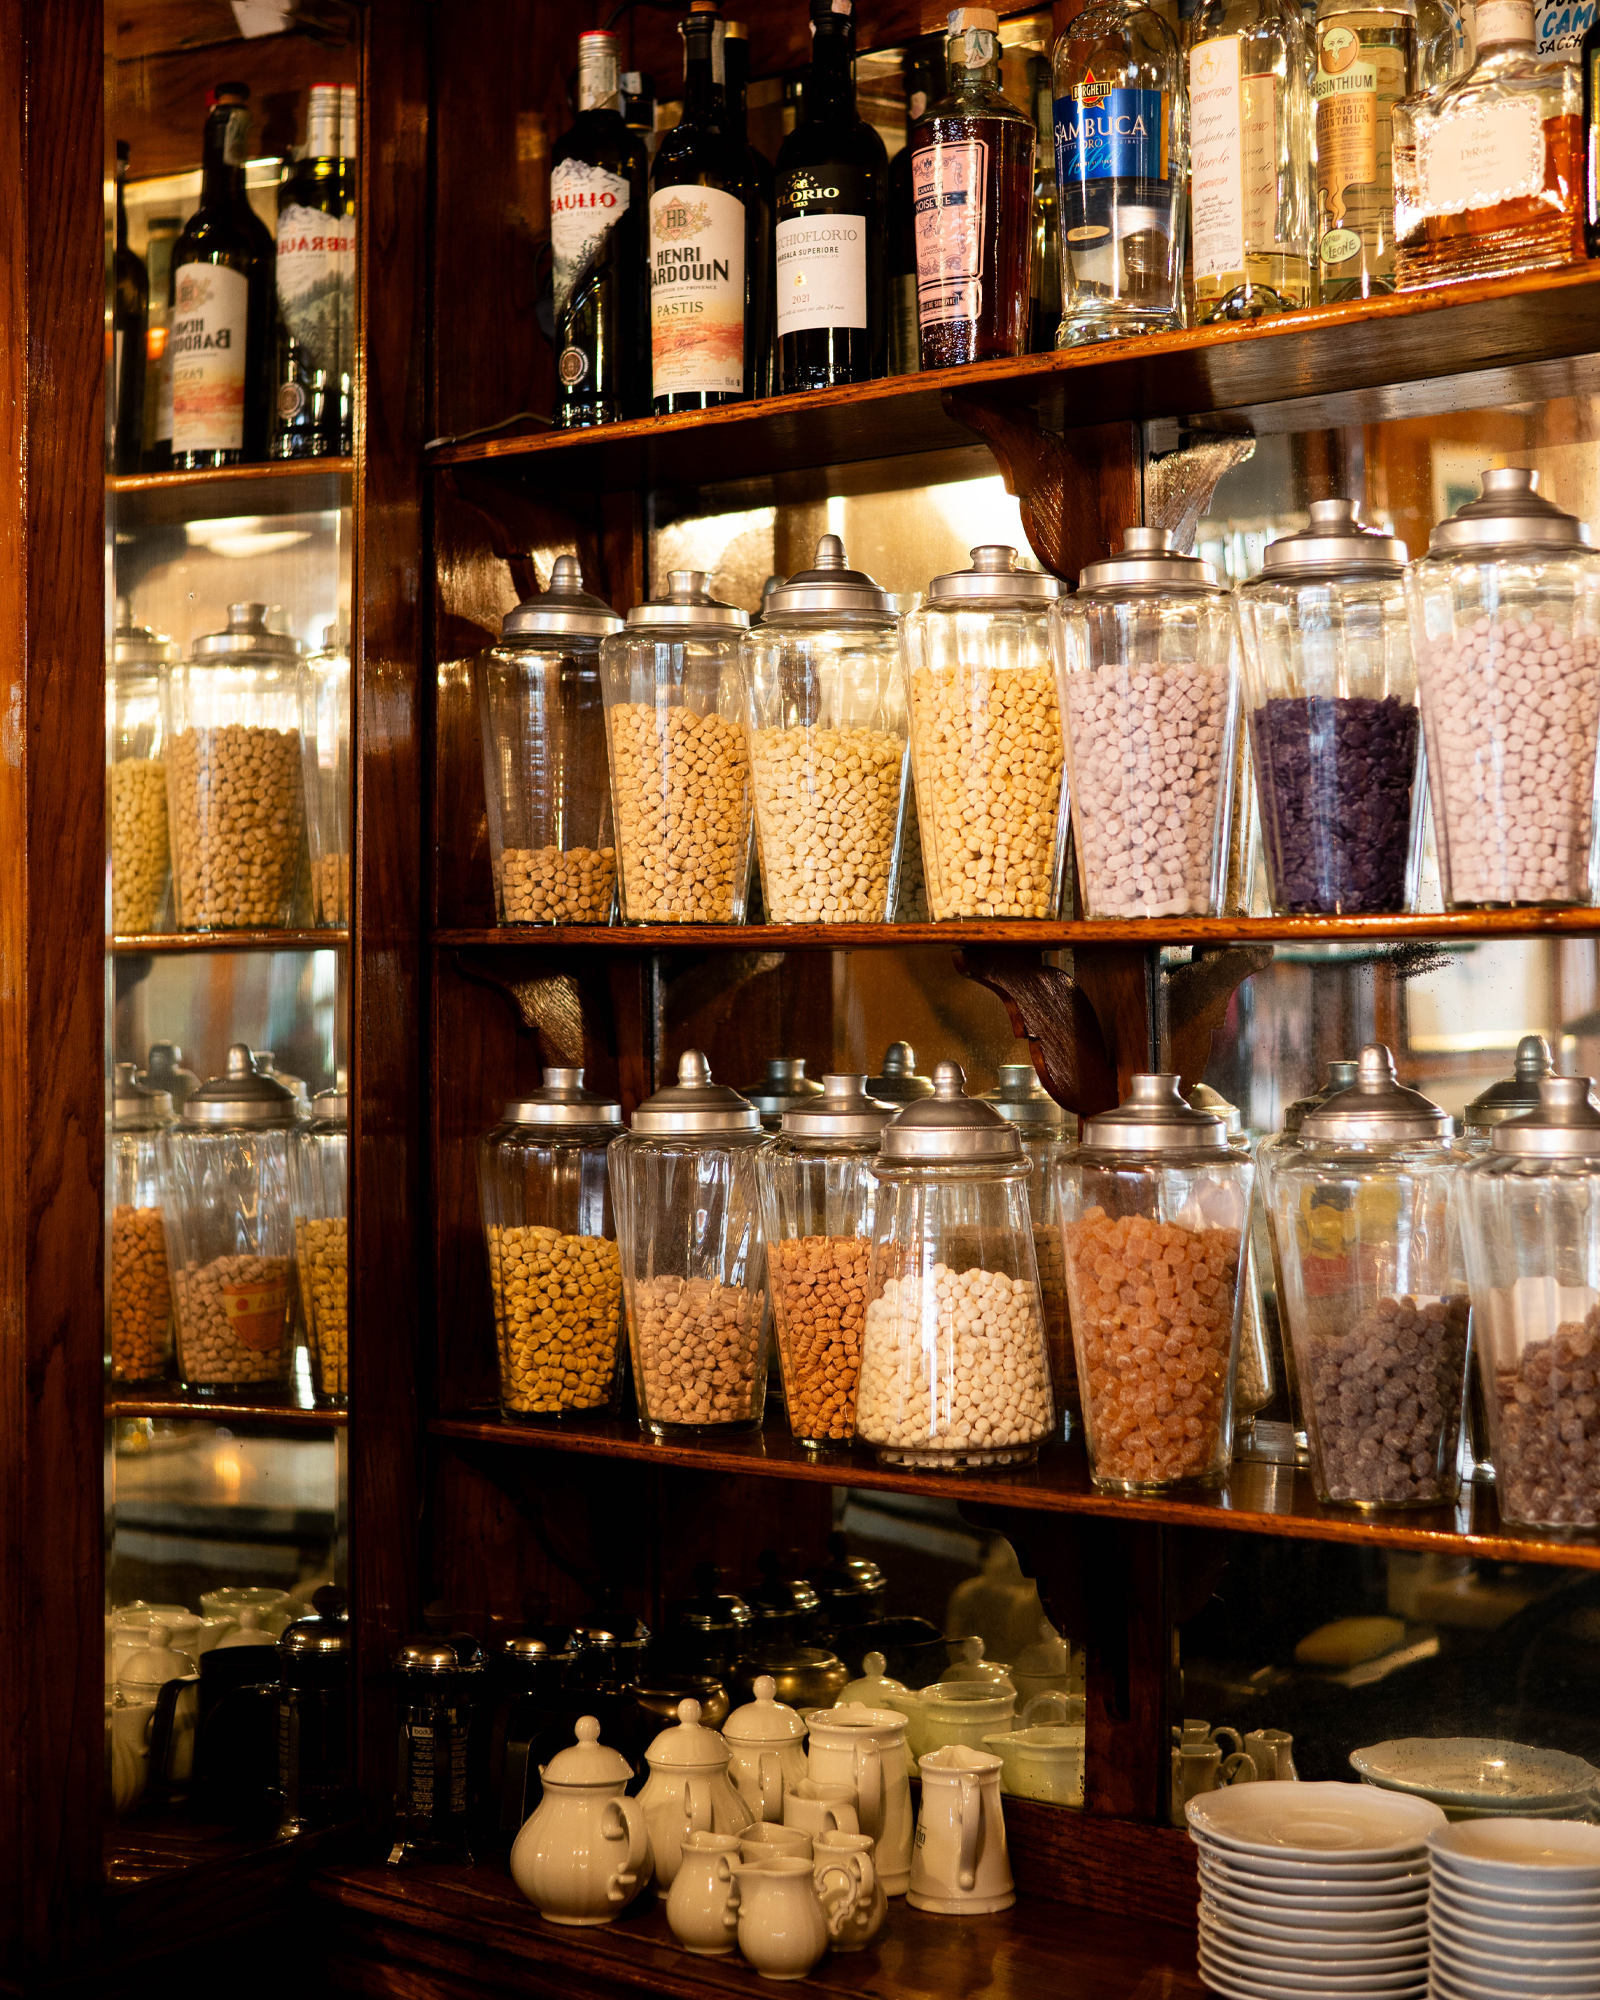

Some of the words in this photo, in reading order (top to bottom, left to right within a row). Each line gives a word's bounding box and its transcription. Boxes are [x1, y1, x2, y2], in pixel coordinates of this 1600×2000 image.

[1316, 75, 1373, 97] ABSINTHIUM
[1055, 114, 1148, 147] SAMBUCA
[1195, 146, 1230, 172] Barolo
[777, 187, 840, 208] FLORIO
[916, 195, 951, 212] NOISETTE
[667, 209, 687, 228] HB
[657, 246, 701, 266] HENRI
[777, 251, 796, 263] MARSALA
[799, 246, 839, 256] SUPERIORE
[651, 259, 729, 287] ARDOUIN
[792, 294, 810, 305] 2021
[657, 301, 704, 318] PASTIS
[414, 1728, 434, 1736] bodu
